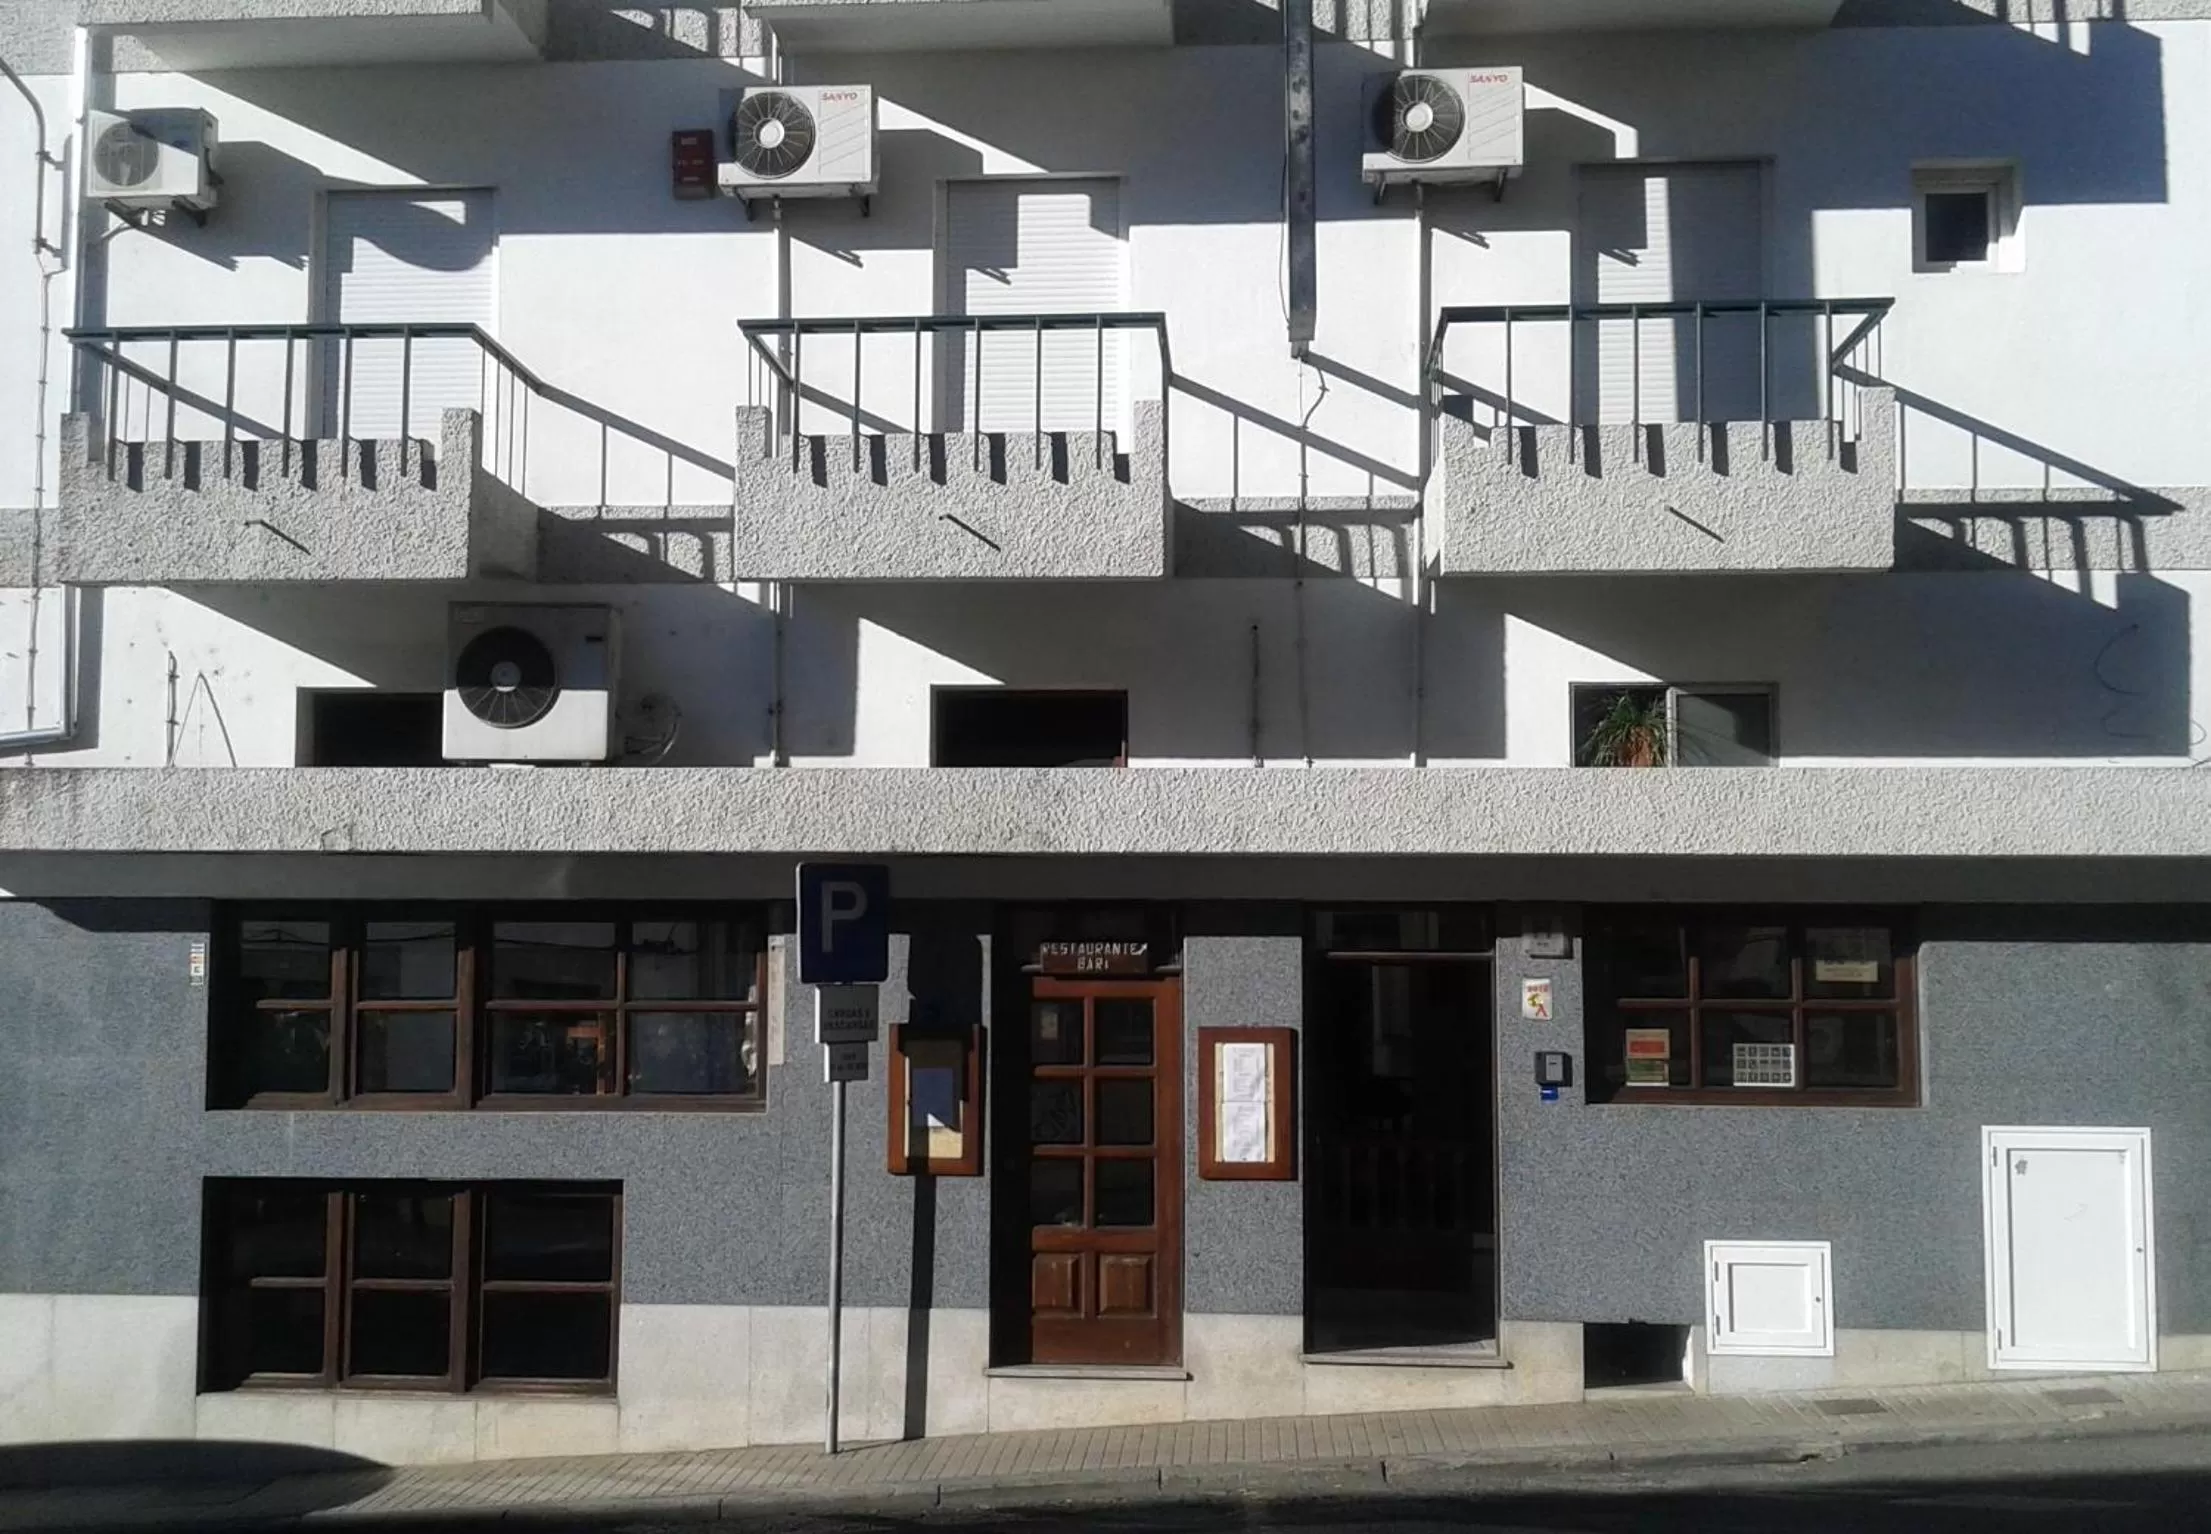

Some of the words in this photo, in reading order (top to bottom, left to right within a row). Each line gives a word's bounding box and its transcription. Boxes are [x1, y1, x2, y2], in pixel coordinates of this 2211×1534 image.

[1469, 74, 1508, 83] SANYO
[822, 92, 858, 101] SANYO
[821, 881, 867, 952] P
